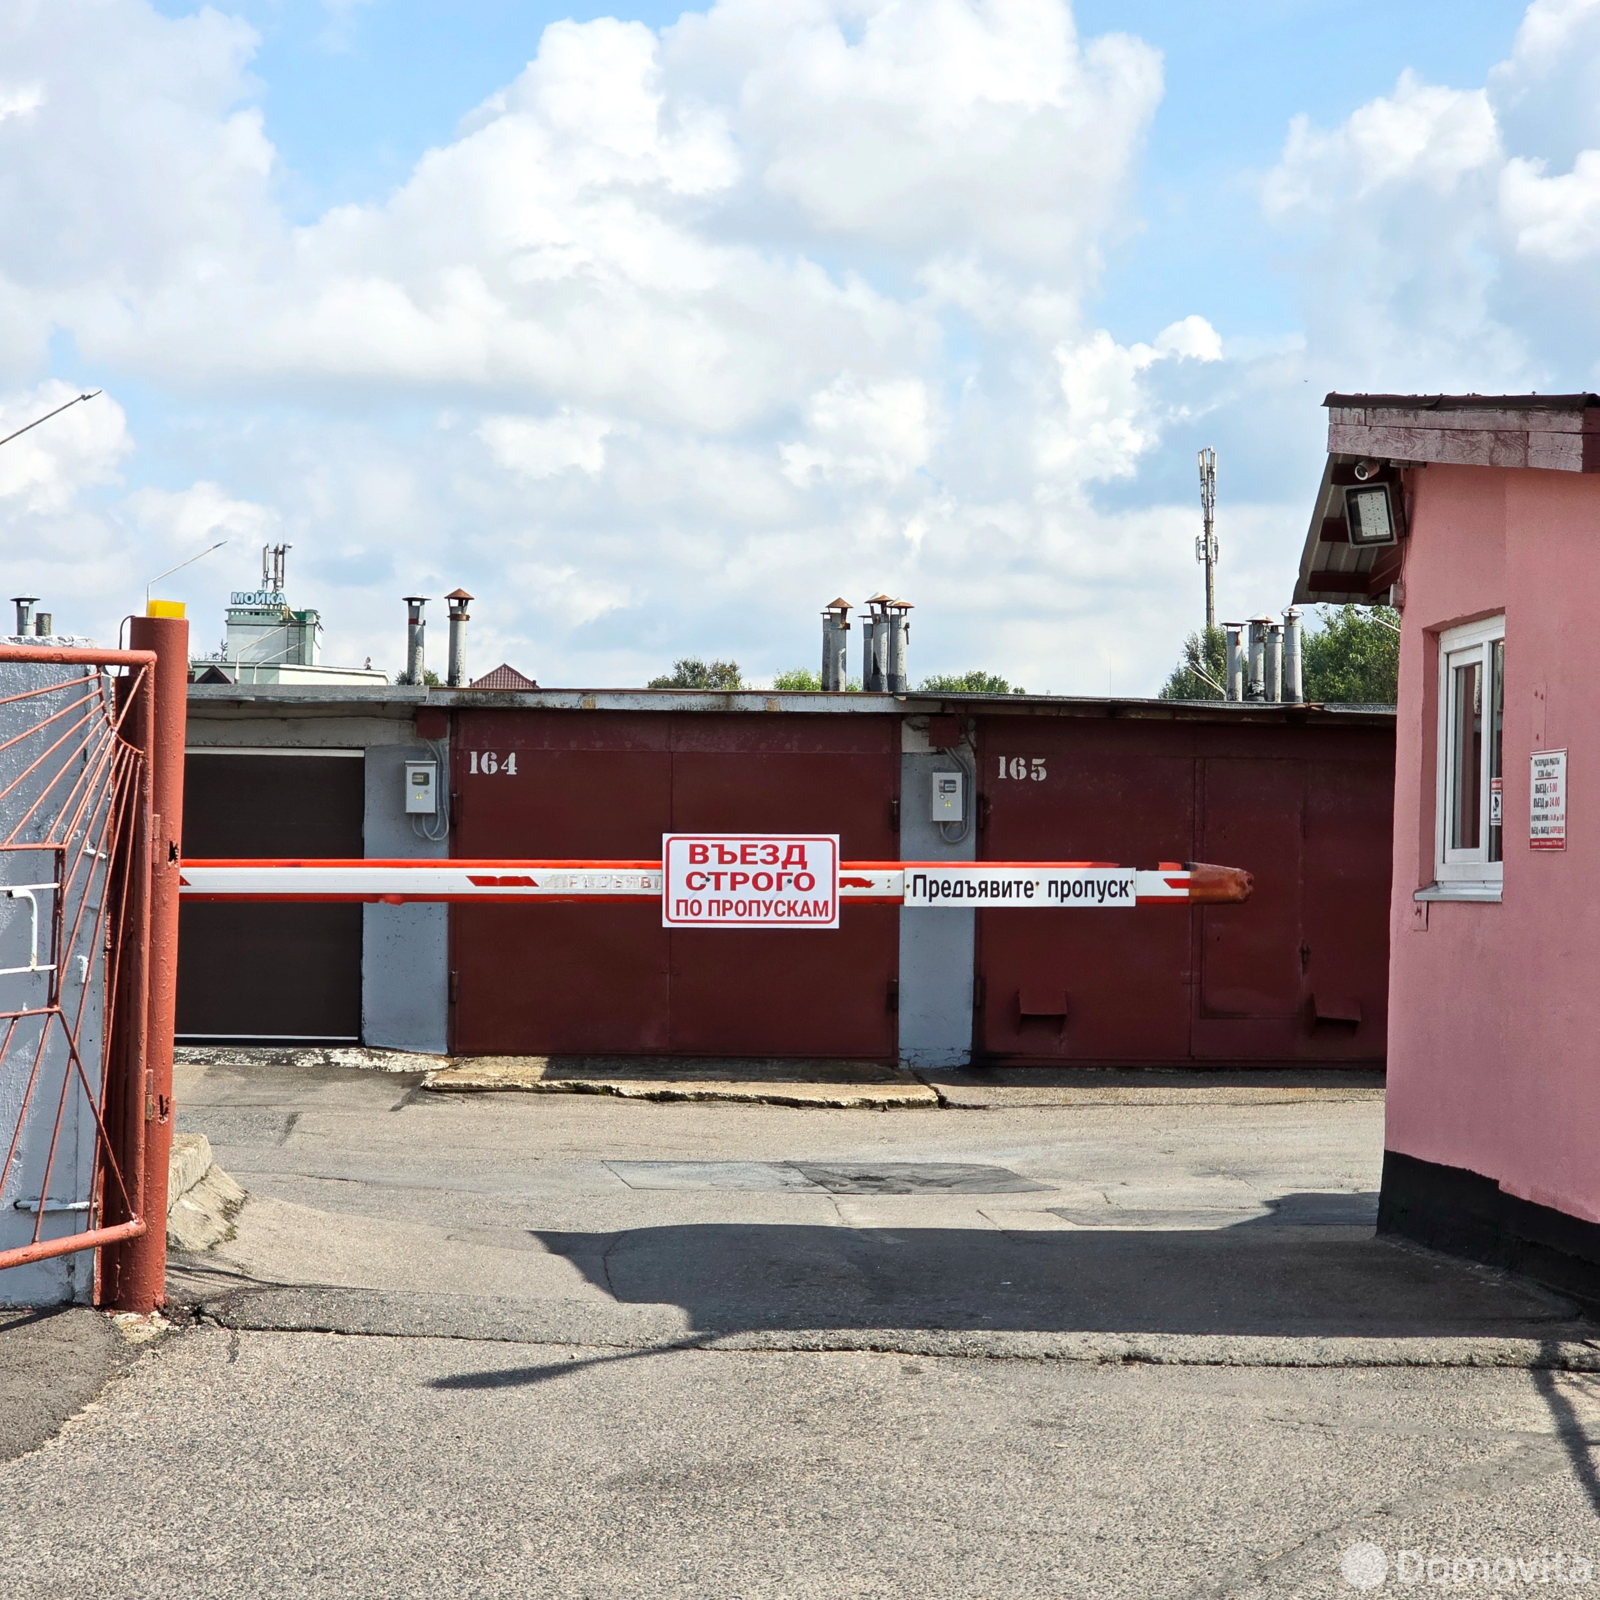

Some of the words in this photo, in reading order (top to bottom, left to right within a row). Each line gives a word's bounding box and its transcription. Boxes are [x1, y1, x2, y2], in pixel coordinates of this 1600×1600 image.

[231, 590, 287, 605] МОЙКА
[469, 751, 518, 775] 164
[997, 756, 1047, 781] 165
[689, 844, 808, 870] ВЪЕЗД
[685, 871, 816, 892] СТРОГО
[912, 874, 1034, 902] Предъявите
[1048, 880, 1130, 903] пропуск
[675, 899, 703, 917] ПО
[708, 900, 829, 917] ПРОПУСКАМ
